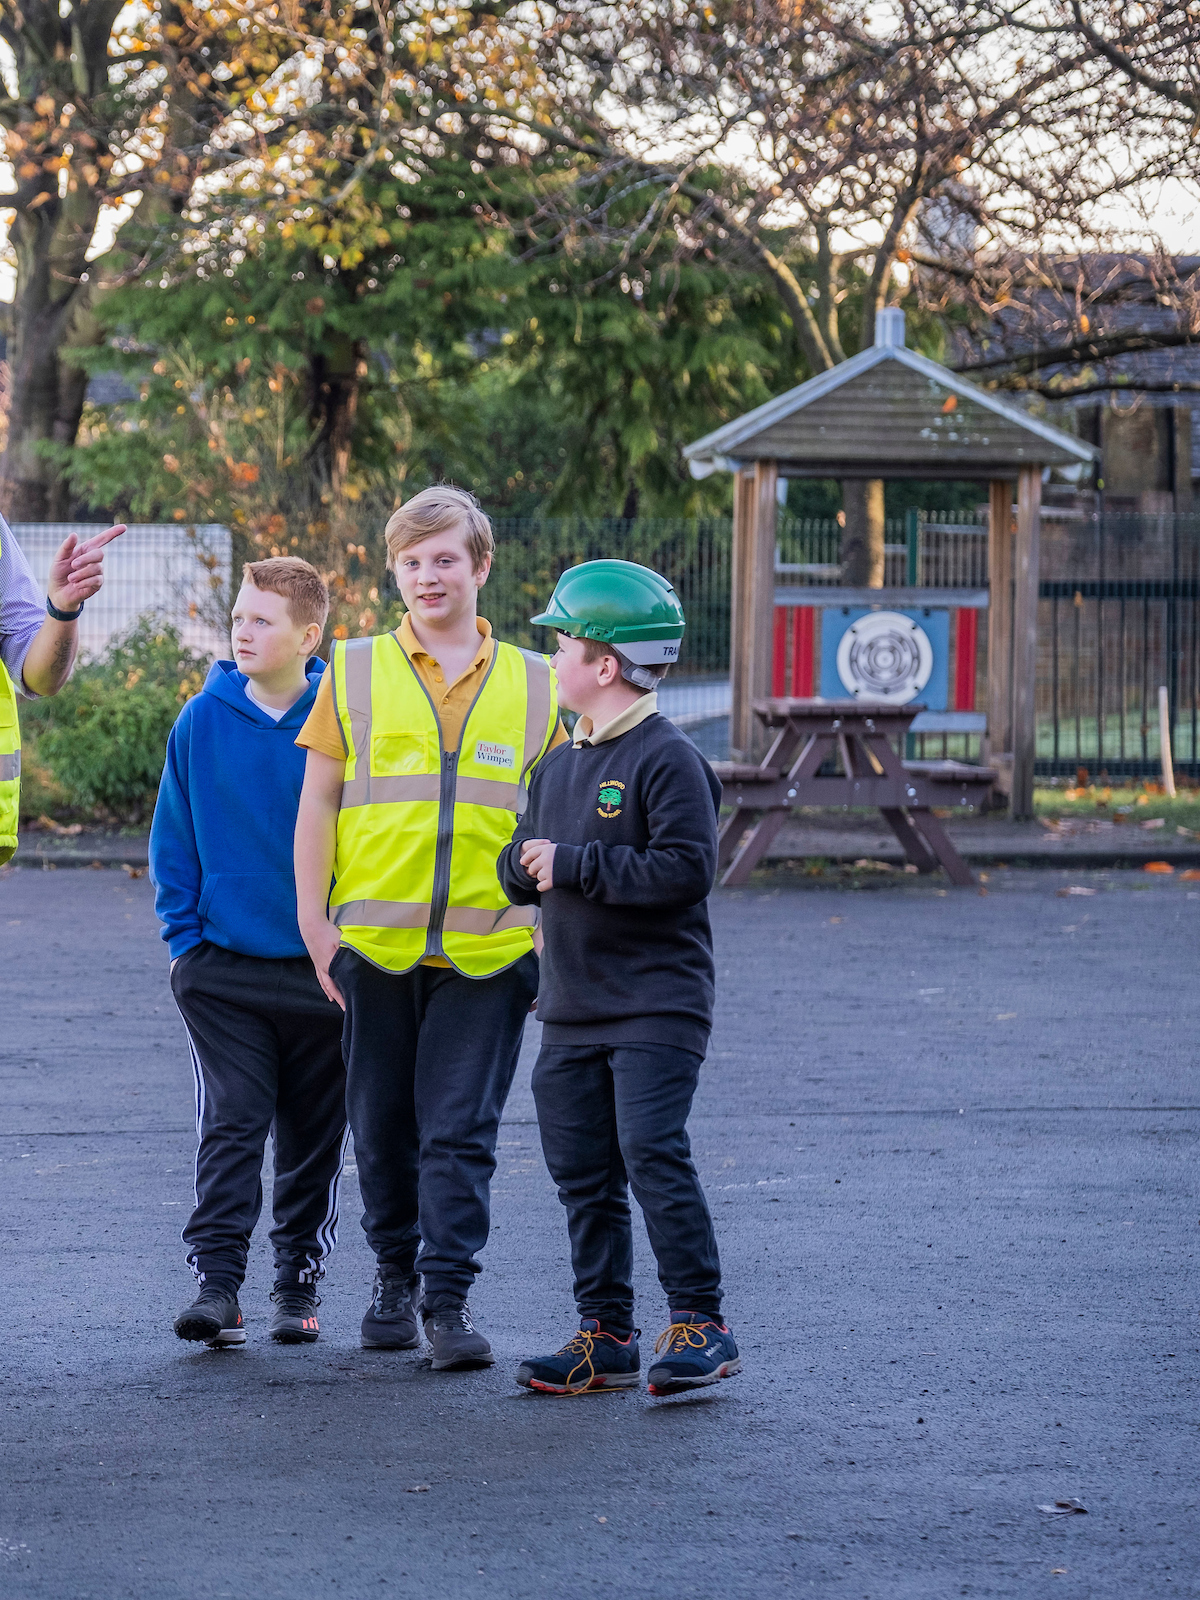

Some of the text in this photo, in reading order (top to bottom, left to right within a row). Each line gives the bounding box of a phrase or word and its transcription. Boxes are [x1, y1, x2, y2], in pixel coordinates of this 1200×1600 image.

[663, 646, 679, 656] TRA
[478, 743, 506, 755] Taylor
[477, 752, 513, 767] Wimpey
[599, 780, 626, 790] HILLWOOD
